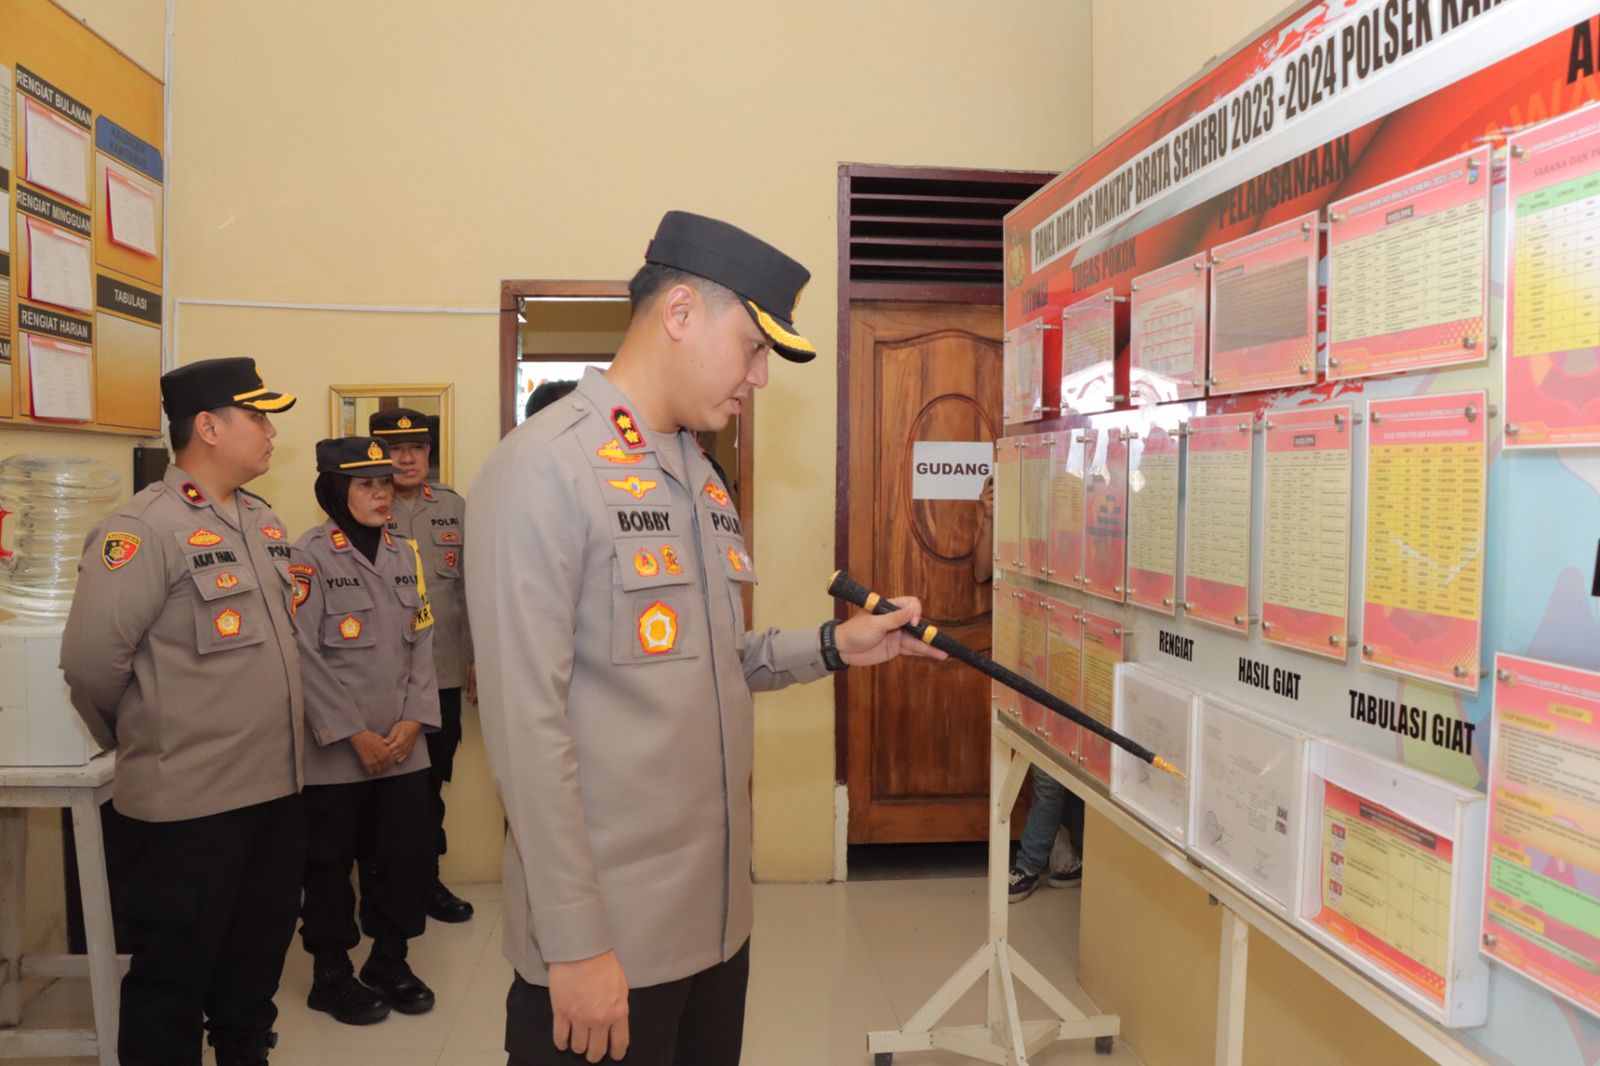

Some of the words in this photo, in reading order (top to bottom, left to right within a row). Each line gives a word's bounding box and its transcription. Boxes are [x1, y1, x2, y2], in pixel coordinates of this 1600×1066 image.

[17, 69, 54, 103] RENGIAT
[55, 93, 92, 125] BULANAN
[1035, 220, 1055, 266] PANEL
[1056, 206, 1076, 252] DATA
[1076, 193, 1093, 240] OPS
[1095, 167, 1134, 230] MANTAP
[1135, 142, 1171, 205] BRATA
[1174, 104, 1228, 183] SEMERU
[1232, 75, 1274, 151] 2023
[1342, 0, 1433, 89] POLSEK
[1219, 132, 1351, 230] PELAKSANAAN
[17, 190, 51, 216] RENGIAT
[52, 205, 91, 233] MINGGUAN
[114, 289, 147, 311] TABULASI
[21, 310, 58, 331] RENGIAT
[59, 319, 89, 338] HARIAN
[916, 463, 989, 475] GUDANG
[430, 518, 459, 527] POLRI
[617, 511, 671, 532] BOBBY
[1159, 630, 1194, 662] RENGIAT
[1238, 657, 1270, 691] HASIL
[1273, 671, 1301, 700] GIAT
[1349, 689, 1427, 742] TABULASI
[1432, 713, 1476, 755] GIAT
